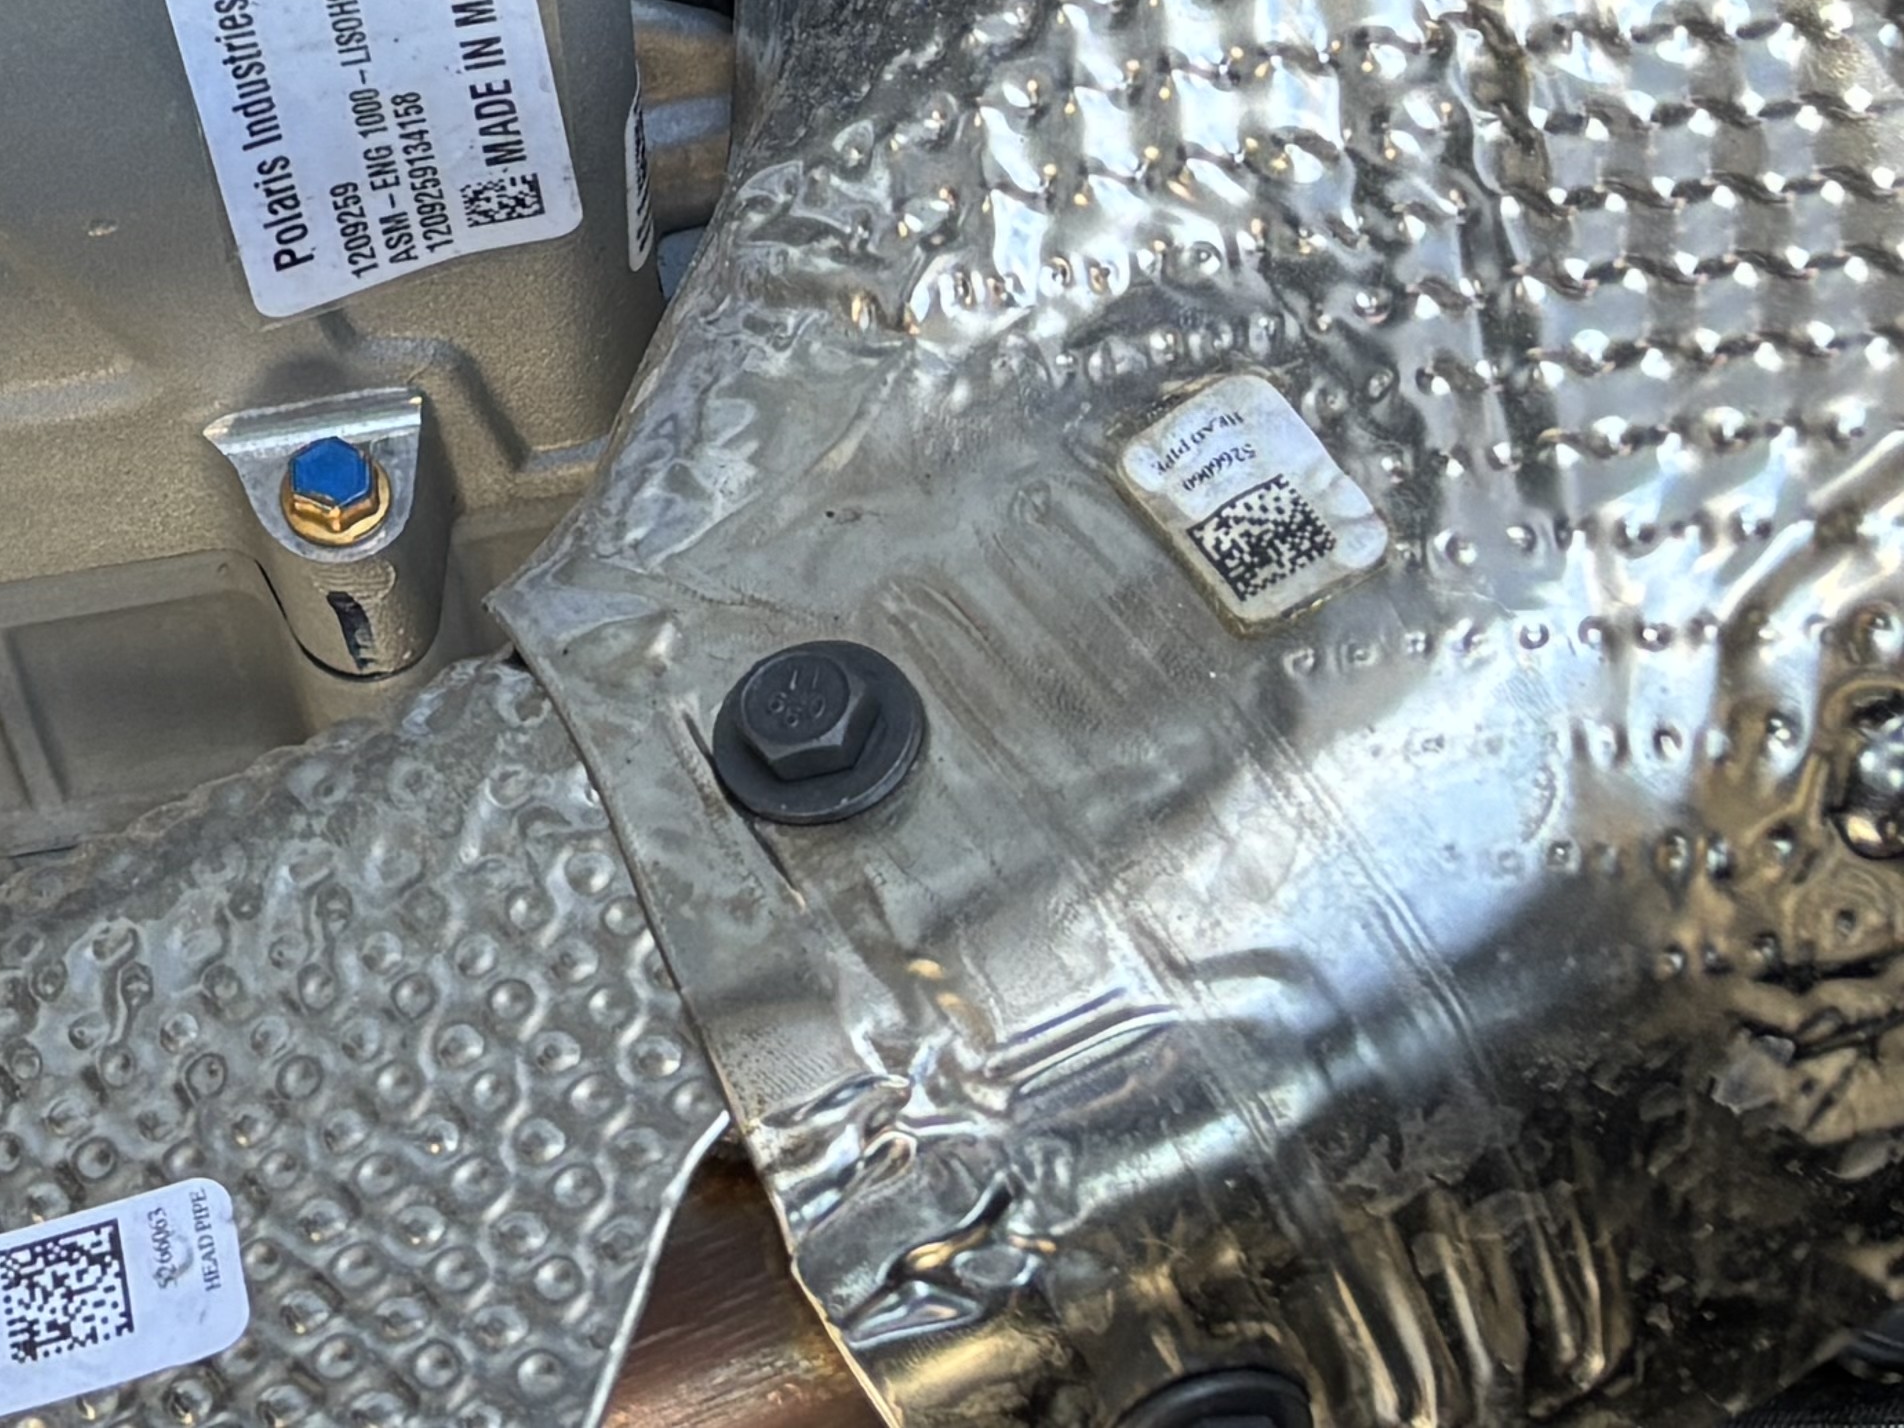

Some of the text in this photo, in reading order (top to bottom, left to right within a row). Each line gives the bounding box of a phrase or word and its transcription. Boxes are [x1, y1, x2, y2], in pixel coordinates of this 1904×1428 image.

[463, 36, 507, 71] IN
[390, 91, 454, 254] 1209259134158
[470, 79, 528, 168] MADE
[255, 155, 314, 272] Polaris
[330, 182, 377, 279] 1209259
[190, 1187, 222, 1292] HEAD PIPE
